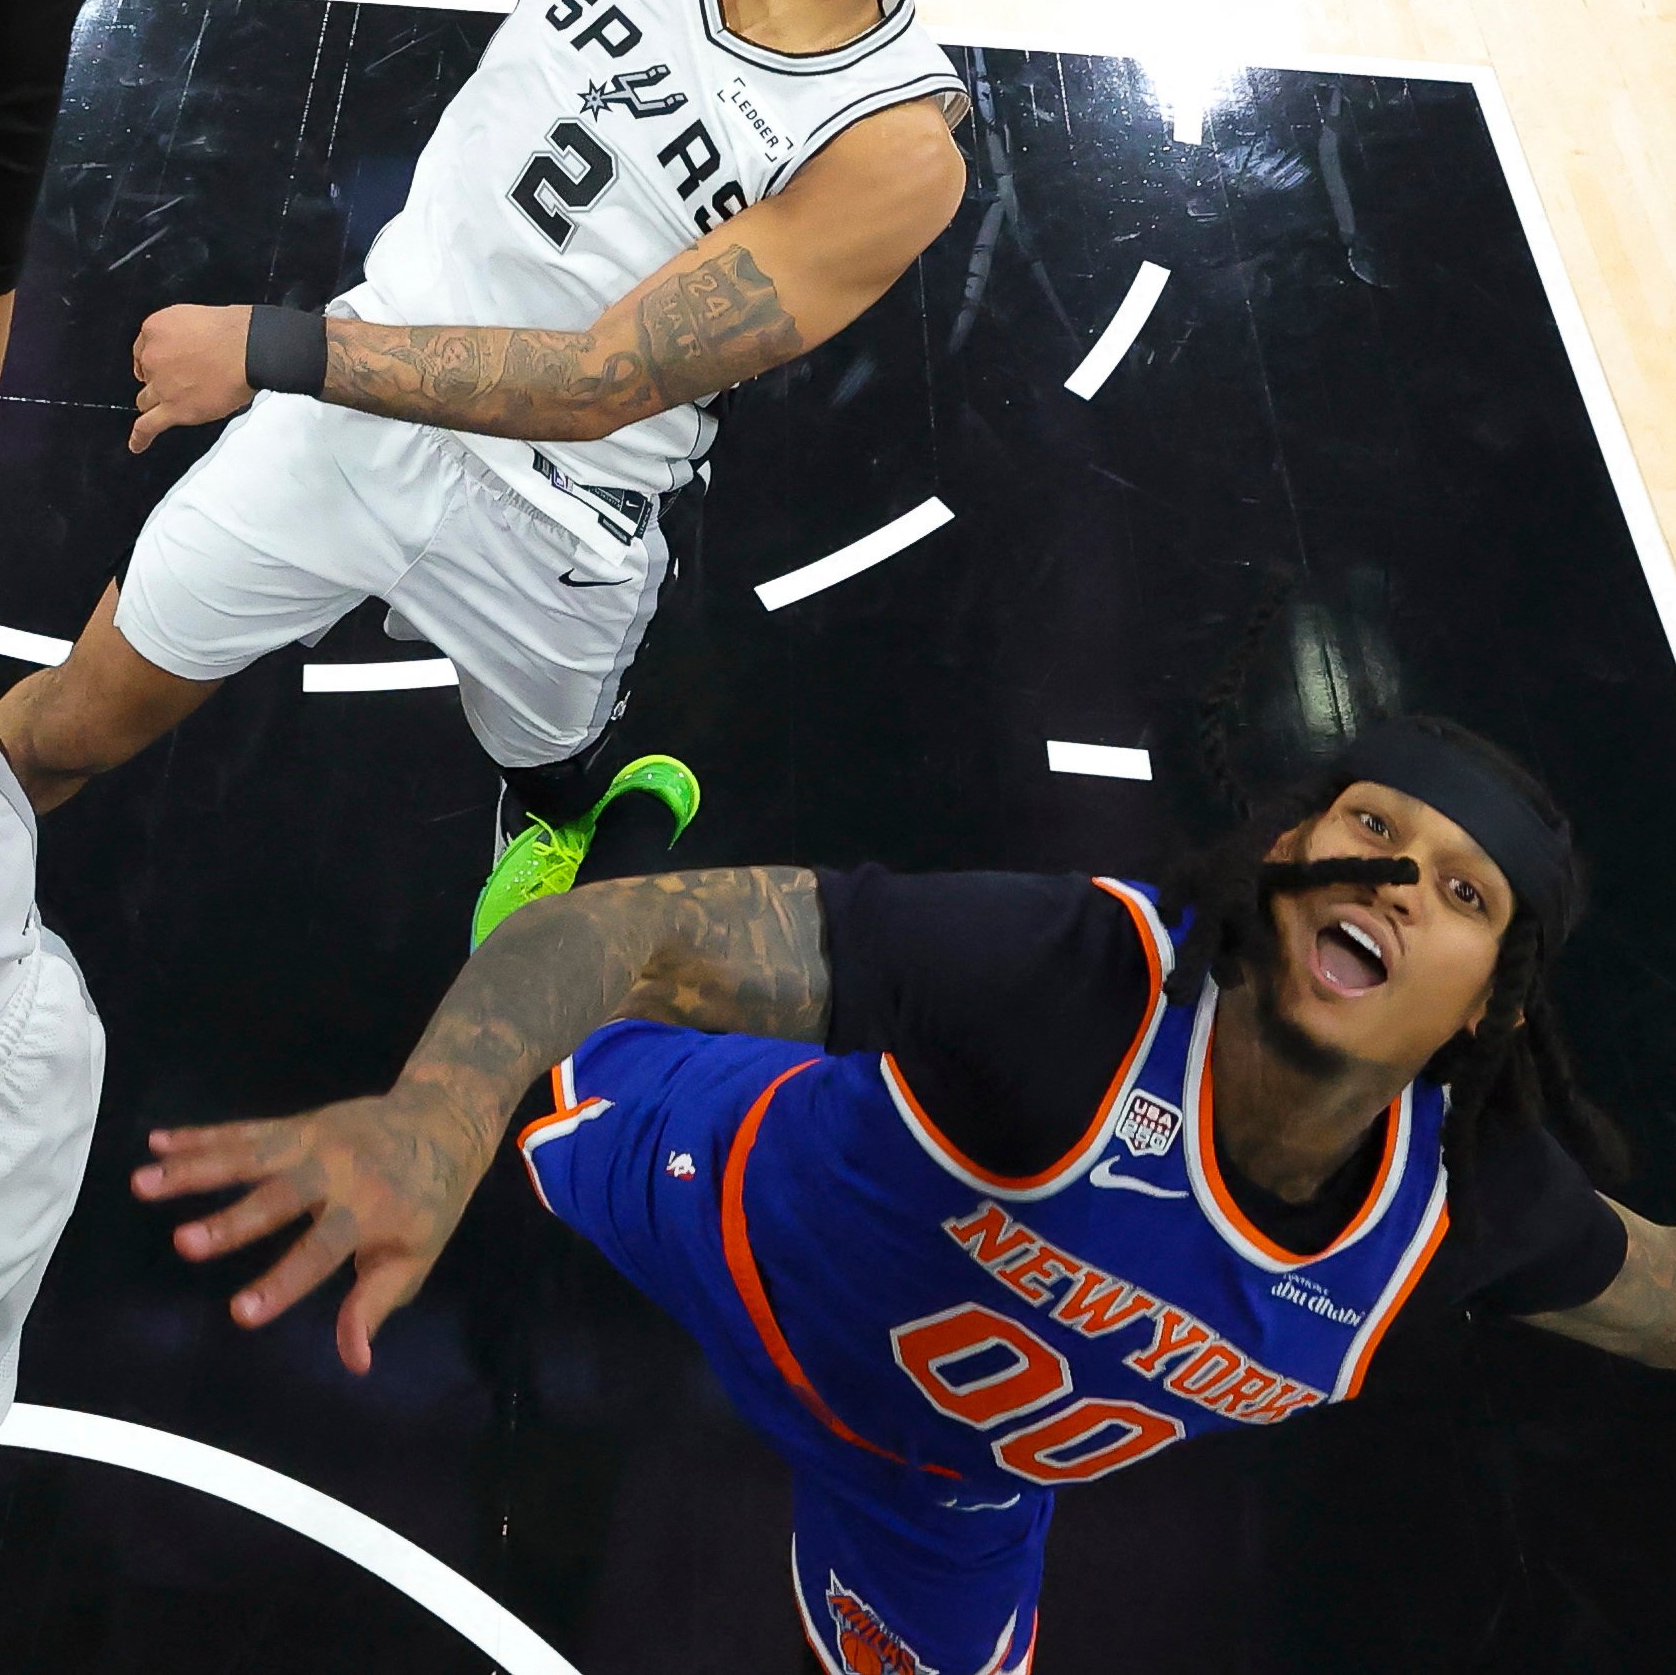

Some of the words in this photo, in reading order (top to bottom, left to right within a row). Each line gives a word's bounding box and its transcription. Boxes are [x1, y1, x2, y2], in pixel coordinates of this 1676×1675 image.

[506, 117, 620, 256] 2
[730, 91, 780, 150] LEDGER
[942, 1199, 1158, 1339] NEW
[1122, 1306, 1329, 1425] YORK
[1271, 1280, 1308, 1307] abu
[1308, 1294, 1366, 1328] dhabi
[889, 1299, 1186, 1486] 00
